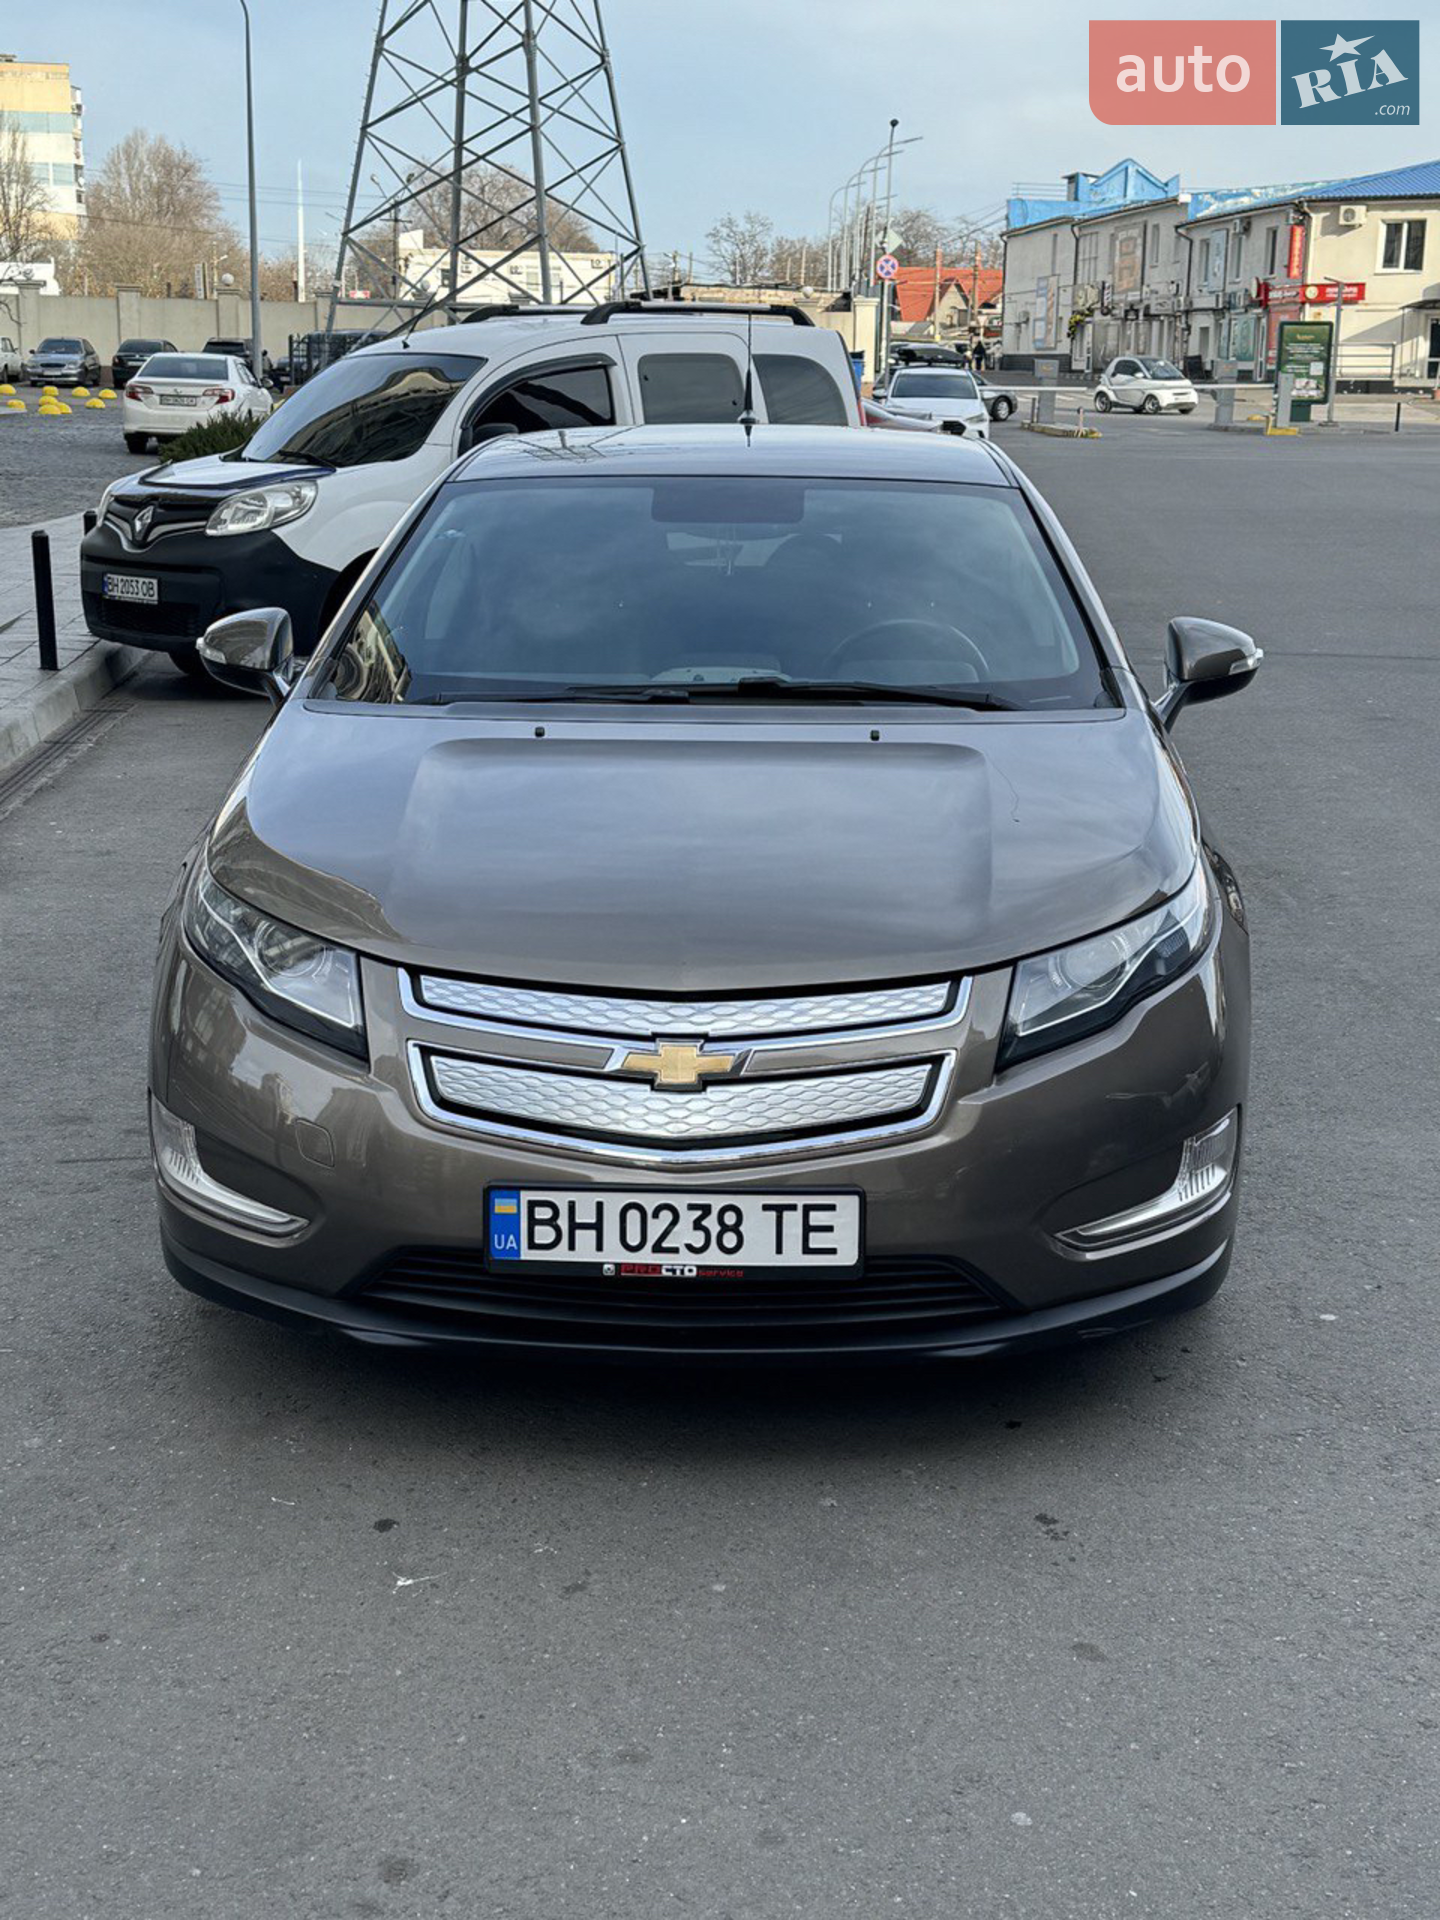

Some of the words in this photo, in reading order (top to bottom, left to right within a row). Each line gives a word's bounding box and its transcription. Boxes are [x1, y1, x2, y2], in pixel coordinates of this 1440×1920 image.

[494, 1233, 518, 1250] UA
[527, 1199, 604, 1252] BH
[619, 1202, 744, 1256] 0238
[761, 1203, 838, 1255] TE
